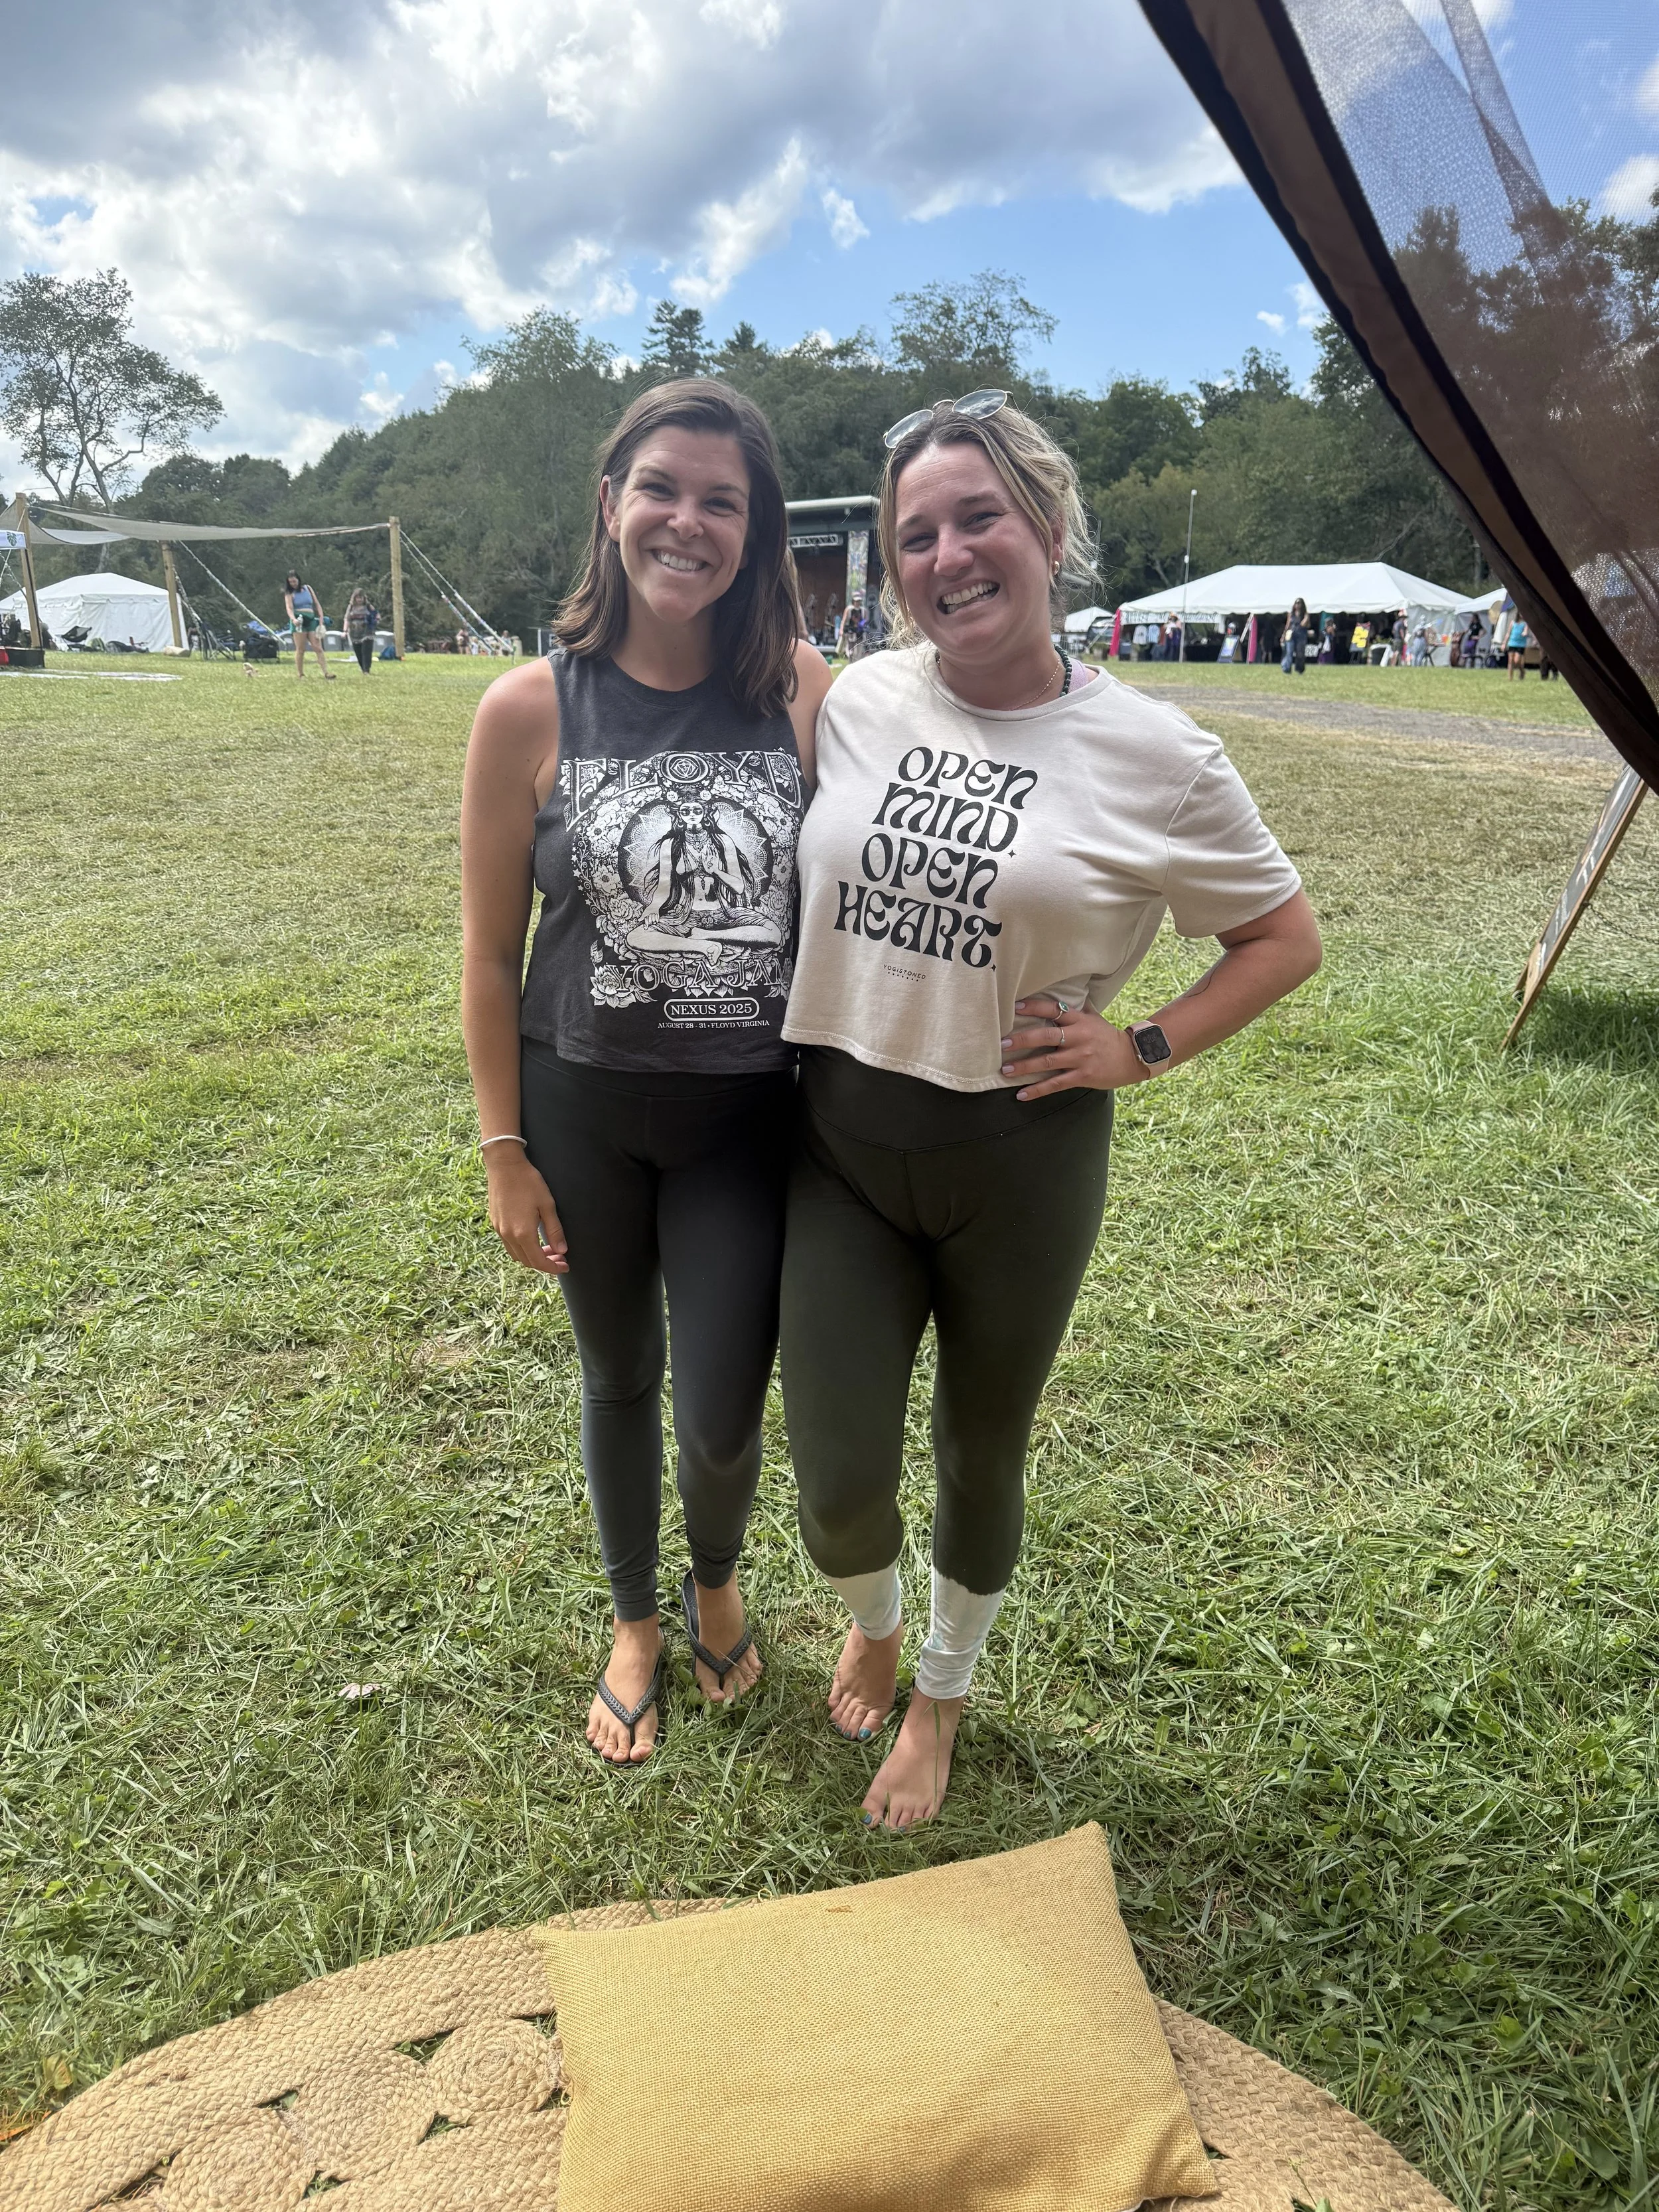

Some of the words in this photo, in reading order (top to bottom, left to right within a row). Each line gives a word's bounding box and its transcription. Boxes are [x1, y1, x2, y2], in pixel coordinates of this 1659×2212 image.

[563, 751, 802, 832] FLOYD
[898, 746, 1039, 810] OPEN
[861, 832, 999, 909] OPEN
[605, 960, 719, 991] YOGA
[727, 958, 790, 988] JAM
[883, 964, 926, 980] YOGISTONED
[670, 1004, 717, 1015] NEXUS
[719, 1003, 753, 1014] 2025
